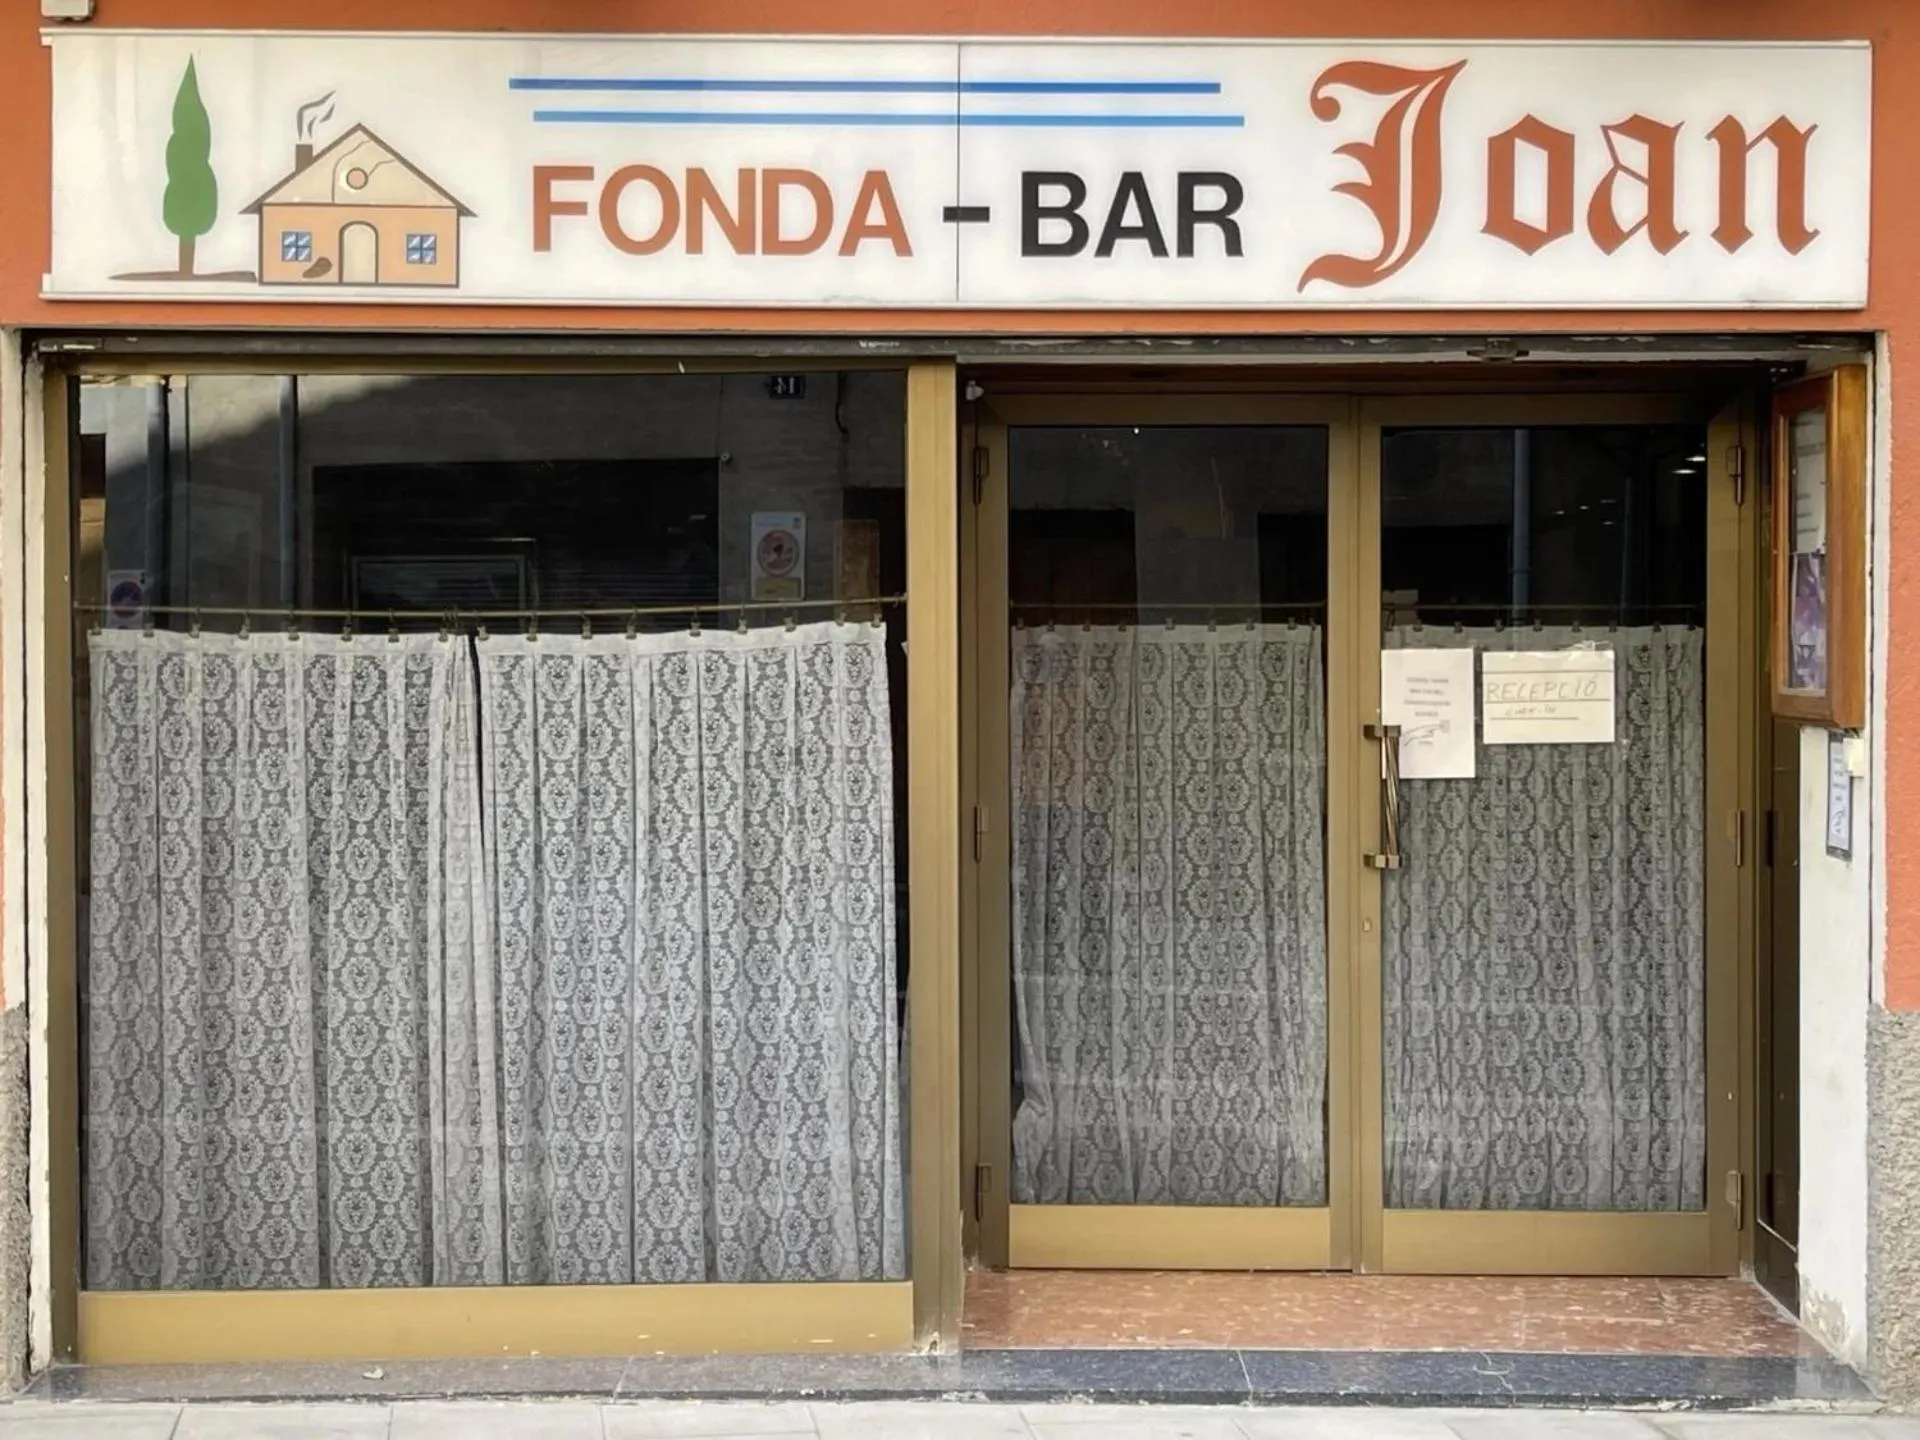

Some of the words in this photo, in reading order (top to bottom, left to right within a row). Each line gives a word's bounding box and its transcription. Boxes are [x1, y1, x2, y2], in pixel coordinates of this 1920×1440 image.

[532, 164, 913, 257] FONDA
[1020, 170, 1245, 257] BAR
[1298, 58, 1820, 293] Joan
[1486, 674, 1599, 701] RECEPCIÓ
